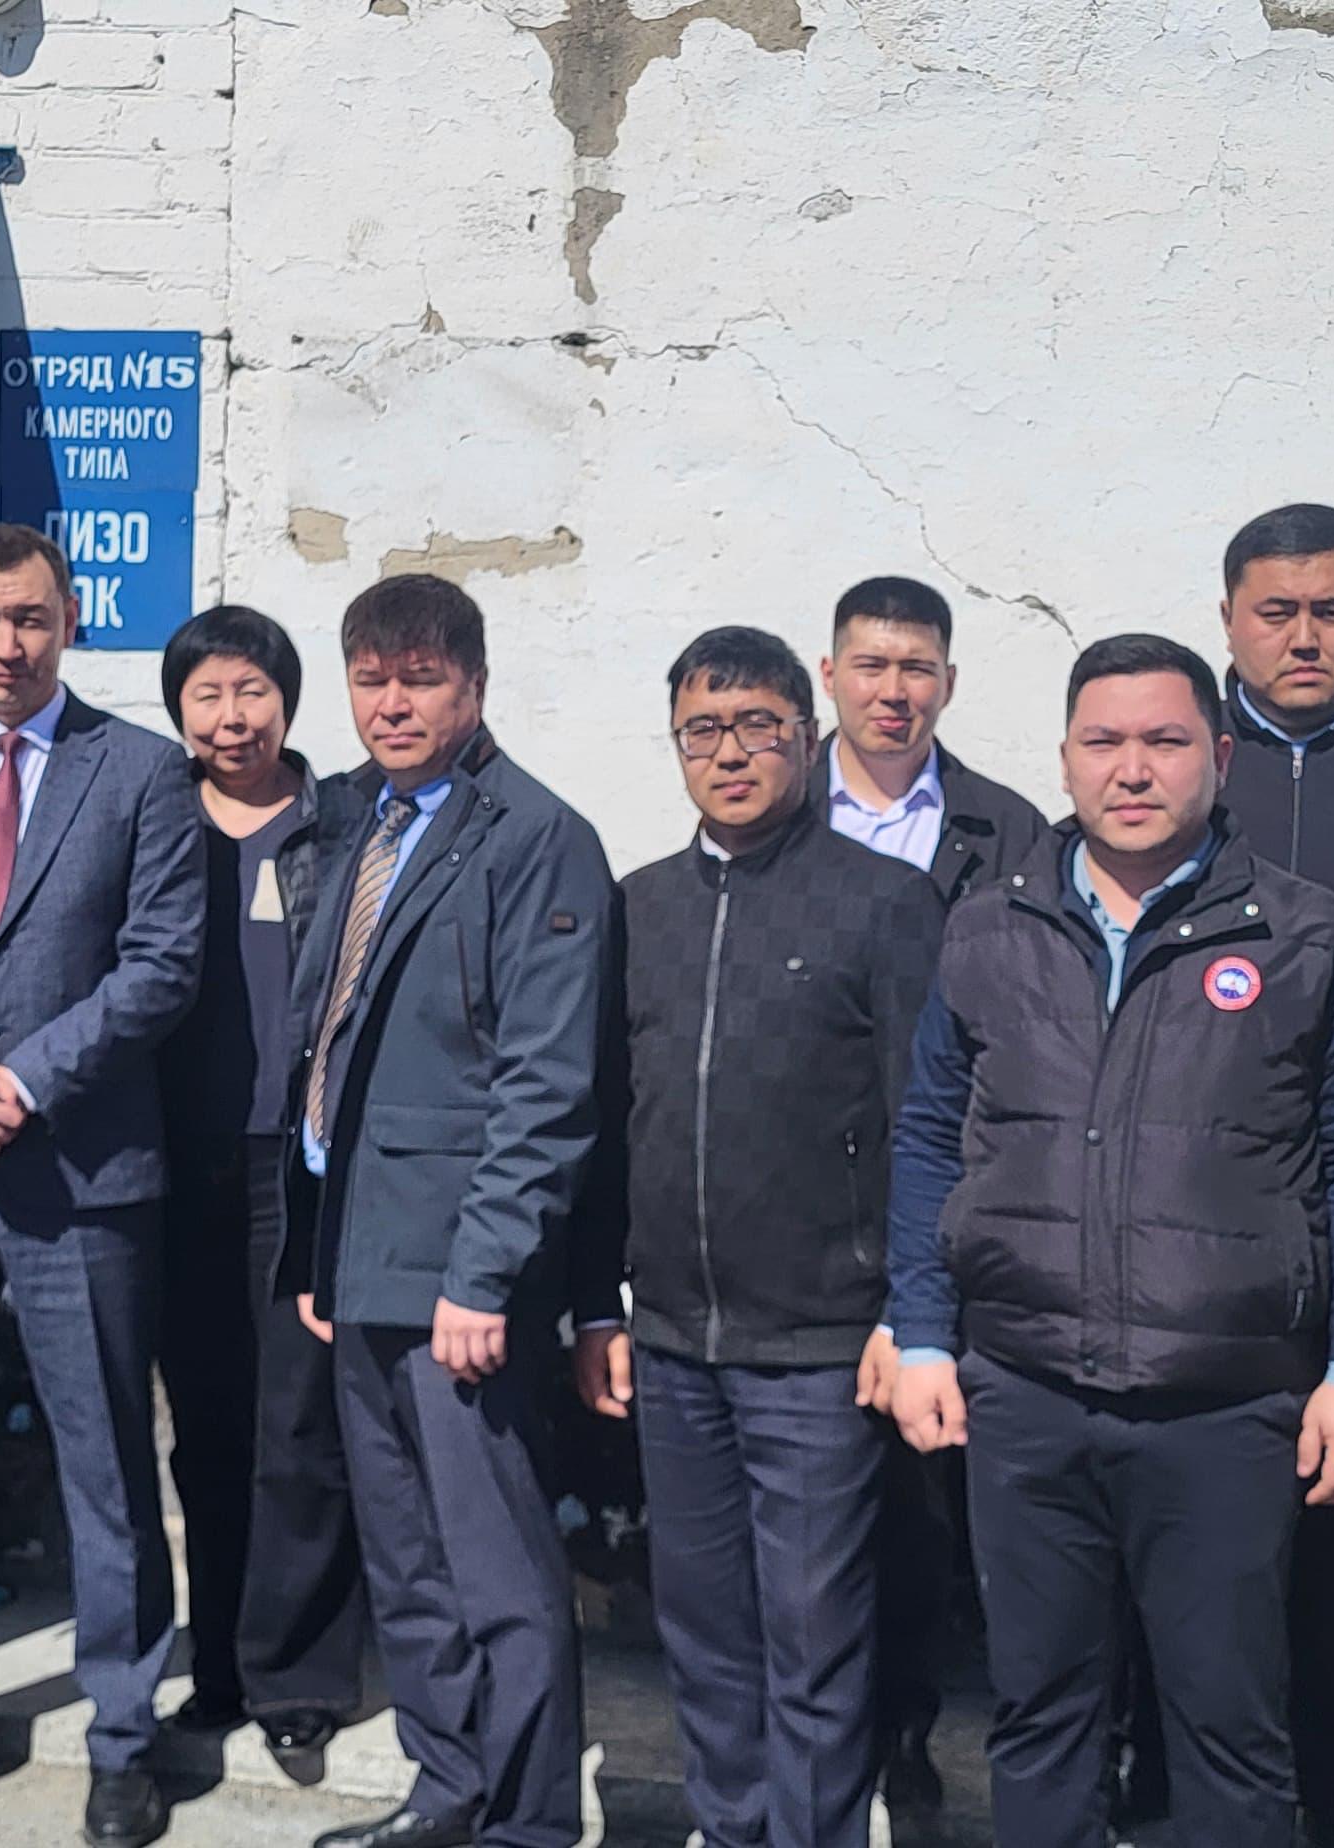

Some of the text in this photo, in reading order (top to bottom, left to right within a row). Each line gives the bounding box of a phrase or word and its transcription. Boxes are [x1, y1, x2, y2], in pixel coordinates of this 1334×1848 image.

[4, 354, 114, 393] ОТРЯД
[24, 405, 173, 440] КАМЕРНОГО
[64, 447, 129, 480] ТИПА
